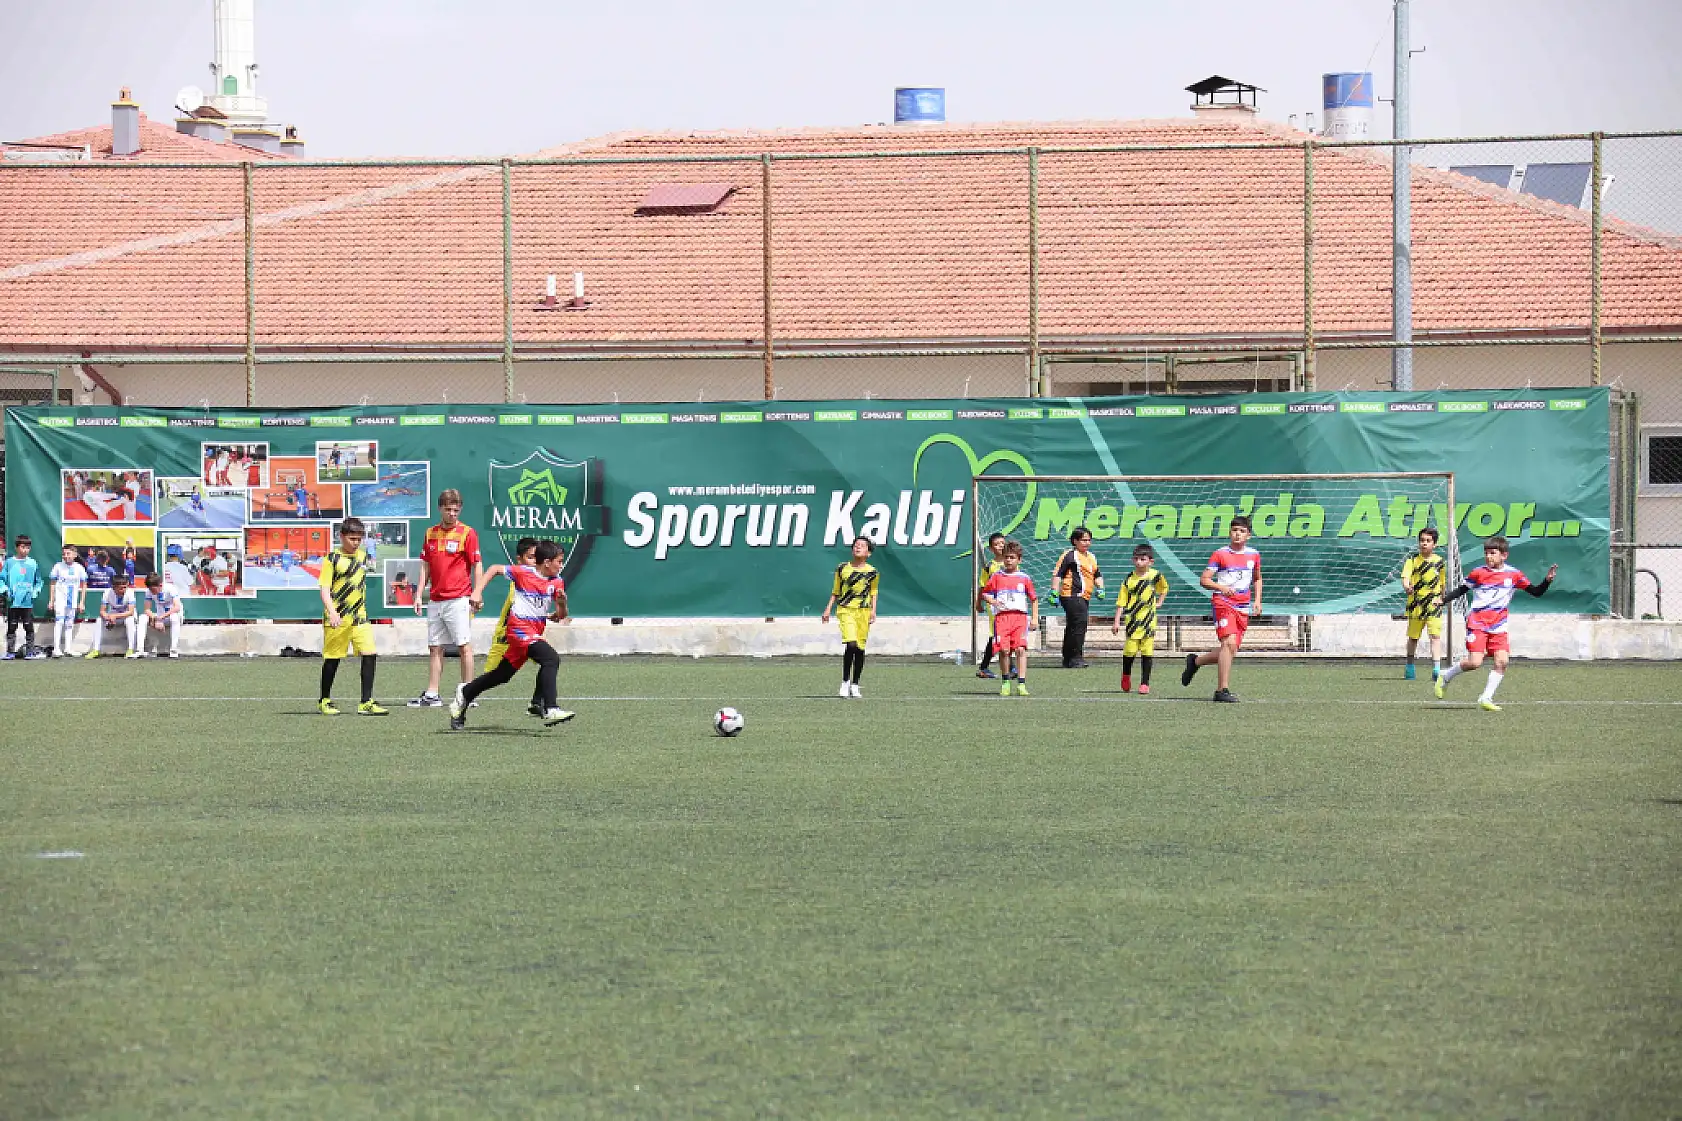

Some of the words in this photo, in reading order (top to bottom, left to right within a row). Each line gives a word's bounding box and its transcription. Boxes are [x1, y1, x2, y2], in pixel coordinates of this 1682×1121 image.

[76, 418, 119, 426] BASKETBOL
[124, 417, 162, 425] VOLEYBOL
[448, 416, 496, 424] TAEKWONDO
[540, 416, 569, 424] FUTBOL
[576, 415, 620, 423] BASKETBOL
[672, 414, 693, 422] MASA
[766, 412, 785, 420] KORT
[957, 410, 1006, 418] TAEKWONDO
[1052, 408, 1081, 416] FUTBOL
[1088, 408, 1134, 416] BASKETBOL
[1140, 407, 1182, 415] VOLEYBOL
[1189, 406, 1212, 415] MASA
[1289, 404, 1309, 413] KORT
[1493, 401, 1546, 410] TAEKWONDO
[668, 483, 817, 497] www.merambelediyespor.com
[491, 505, 584, 530] MERAM
[623, 491, 809, 560] Sporun
[823, 489, 966, 547] Kalbi
[1034, 493, 1325, 540] Meram'da
